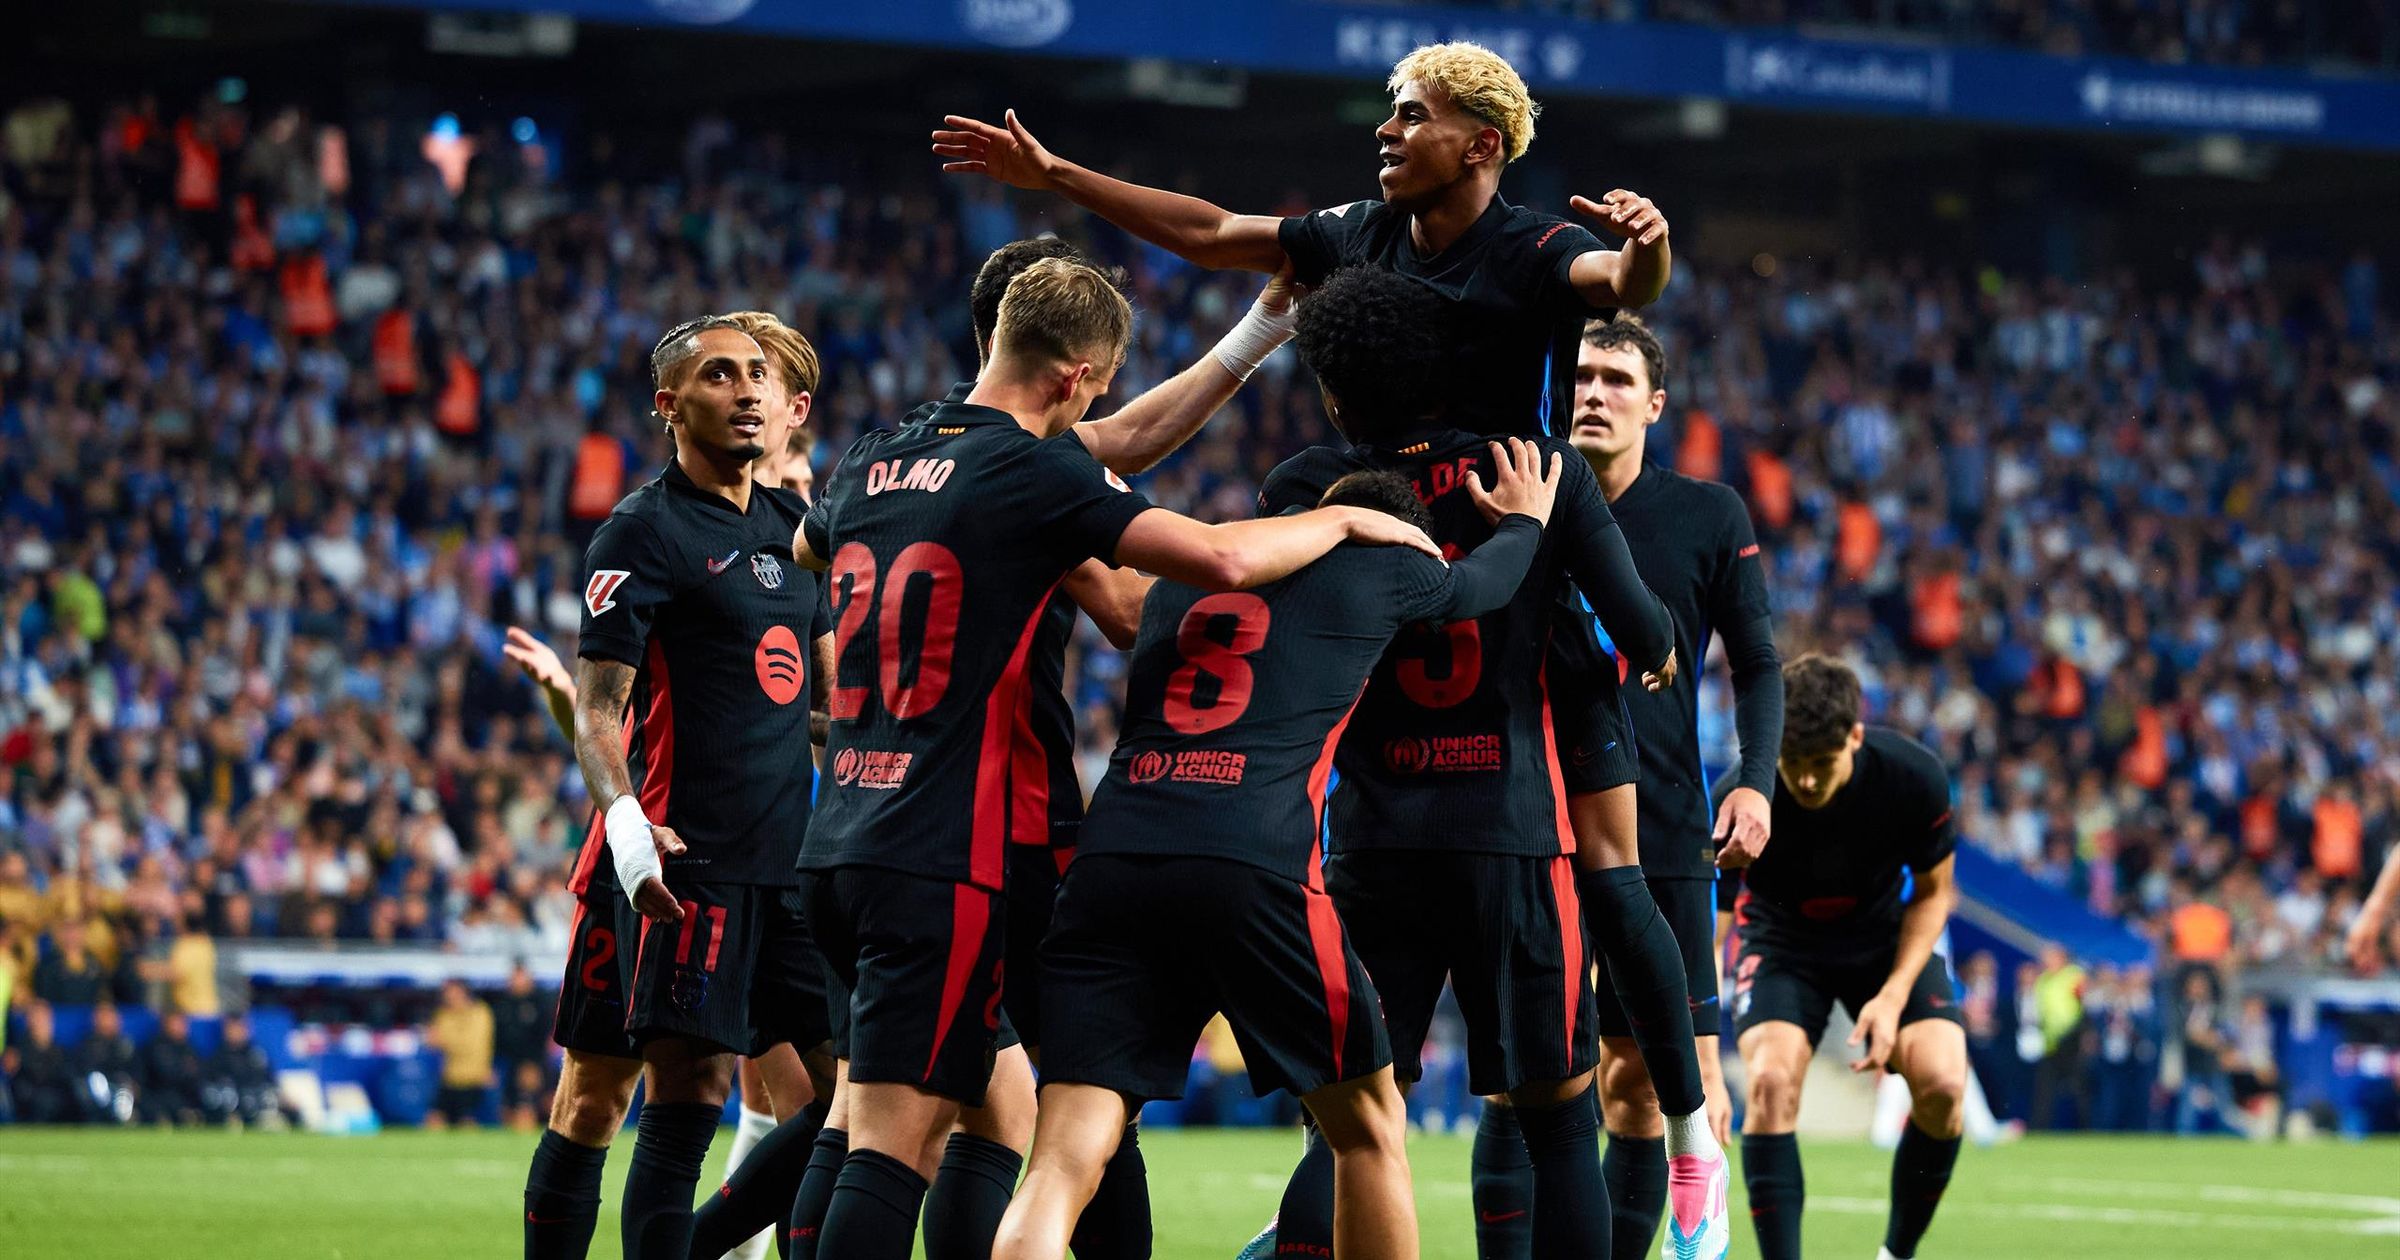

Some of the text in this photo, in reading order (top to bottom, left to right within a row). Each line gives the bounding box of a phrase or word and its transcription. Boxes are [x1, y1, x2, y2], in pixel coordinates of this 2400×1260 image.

[866, 458, 956, 496] OLMO
[830, 541, 964, 720] 20
[1163, 592, 1271, 735] 8
[1432, 735, 1500, 751] UNHCR
[1176, 751, 1247, 768] UNHCR
[1432, 749, 1500, 766] ACNUR
[1171, 764, 1243, 781] ACNUR
[675, 900, 728, 973] 11
